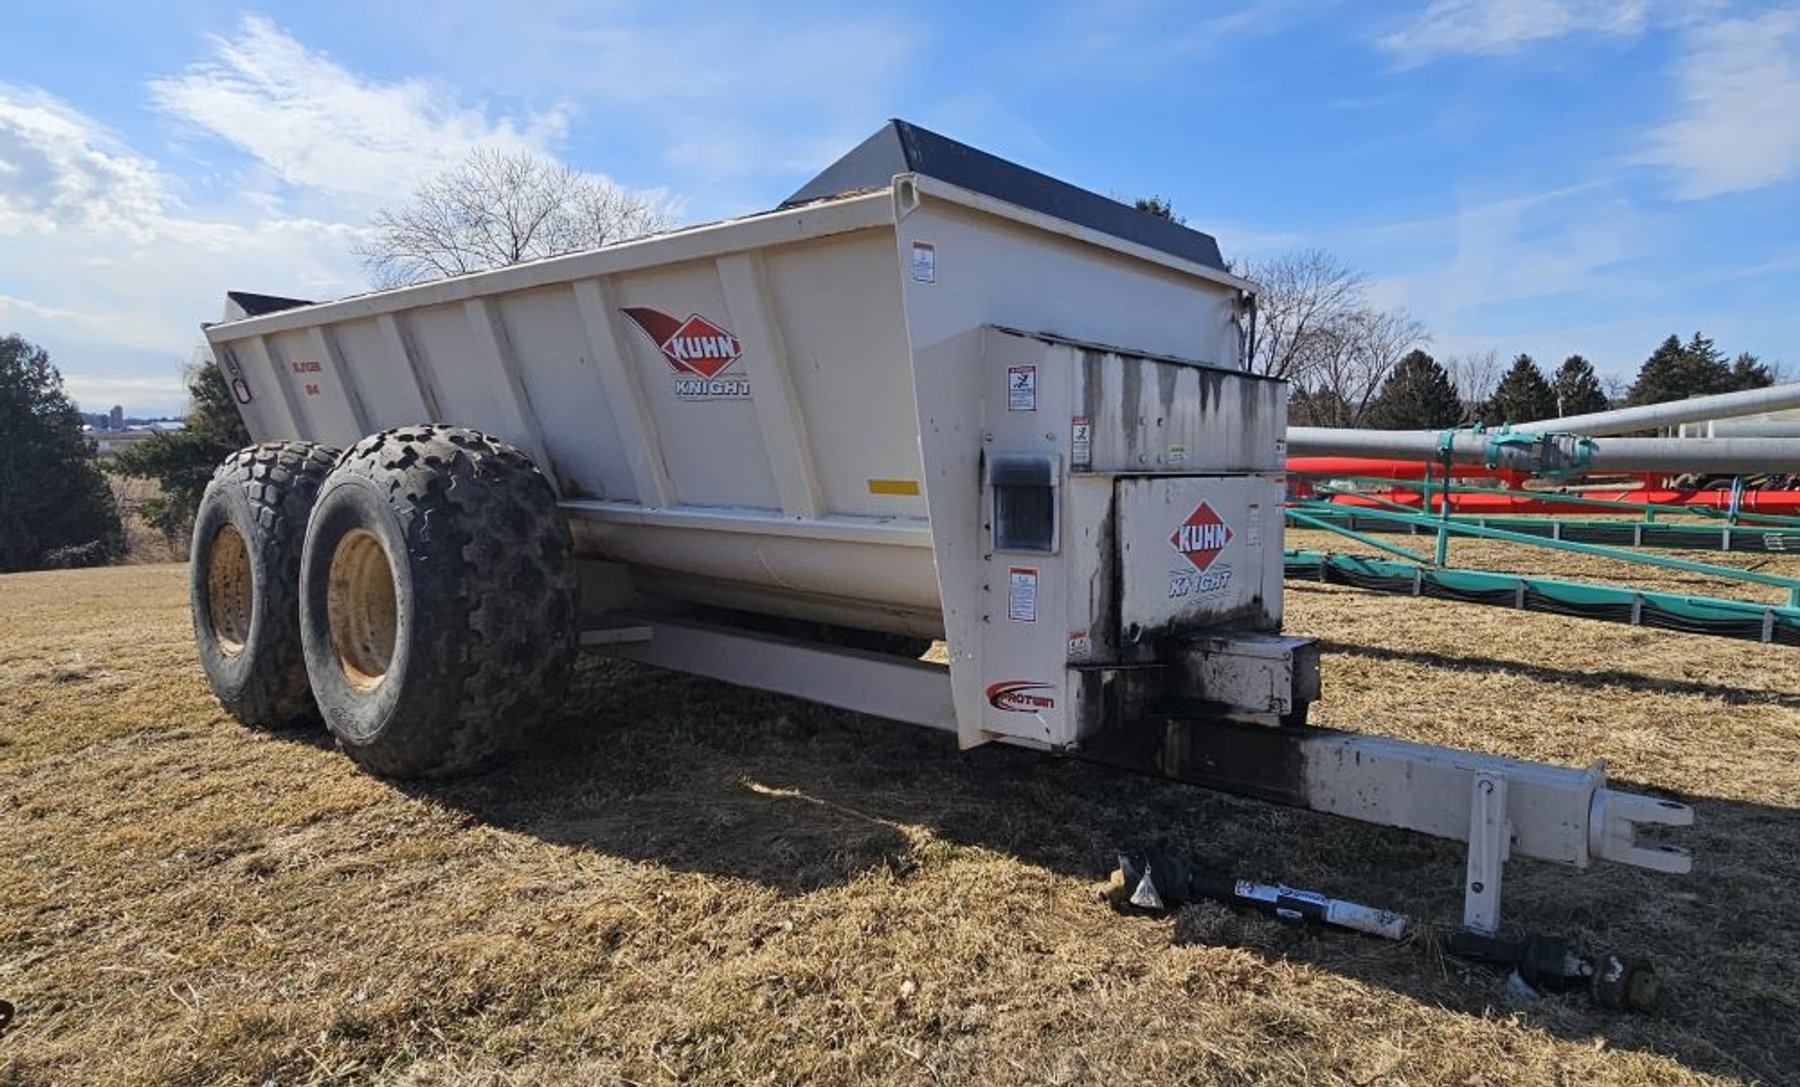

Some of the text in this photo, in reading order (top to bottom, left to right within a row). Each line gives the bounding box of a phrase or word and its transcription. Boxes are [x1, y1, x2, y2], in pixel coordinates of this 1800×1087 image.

[673, 336, 735, 359] KUHN
[676, 380, 751, 395] KNIGHT
[1178, 523, 1226, 552] KUHN
[1169, 572, 1231, 598] KNIGHT
